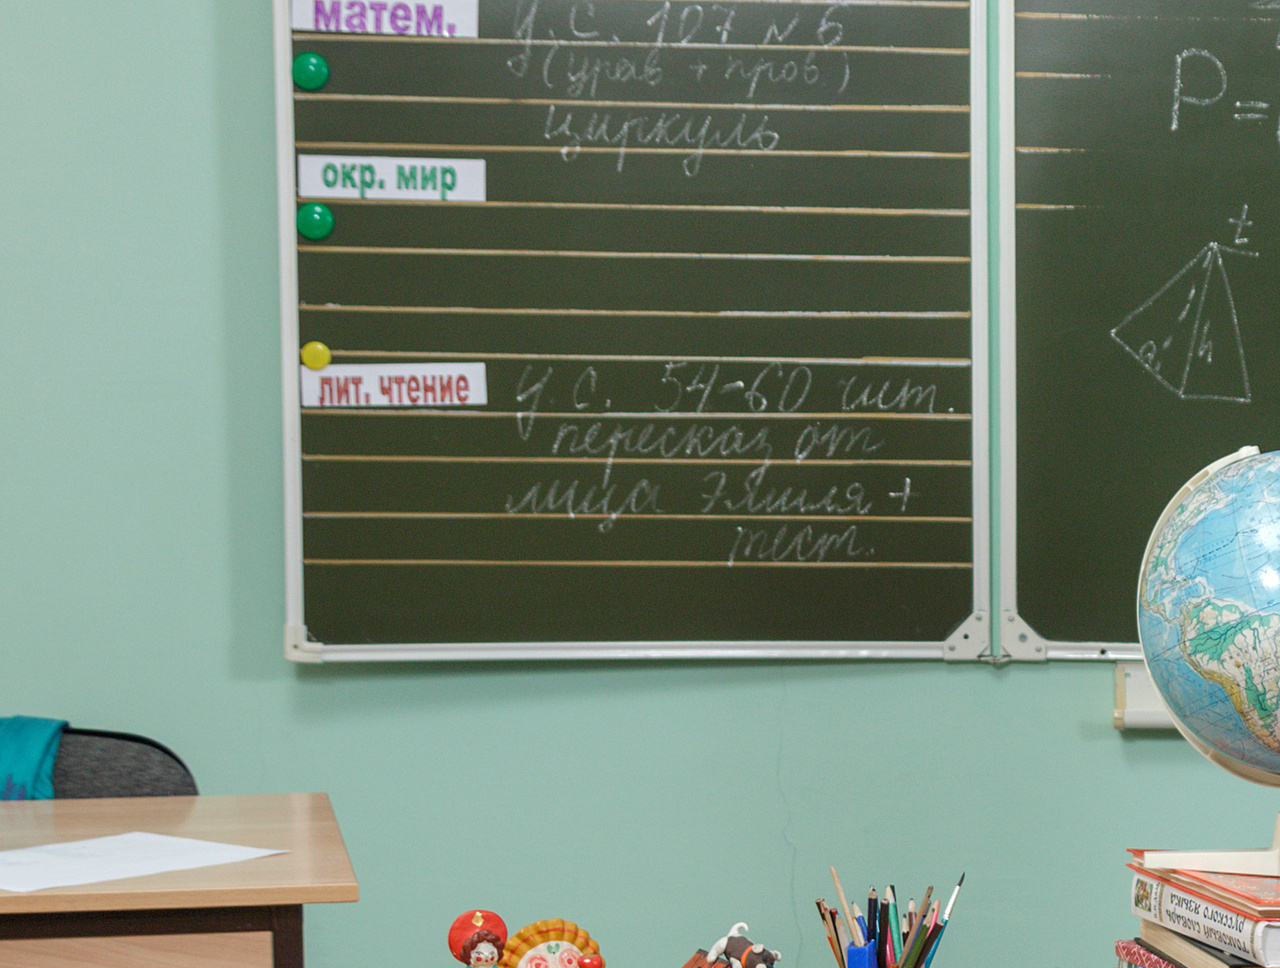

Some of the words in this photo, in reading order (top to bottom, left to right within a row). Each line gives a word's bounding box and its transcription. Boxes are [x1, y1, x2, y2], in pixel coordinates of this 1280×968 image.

[322, 162, 386, 200] окр.
[396, 164, 458, 200] мир
[319, 375, 372, 405] лит.
[379, 373, 471, 405] чтение
[794, 421, 884, 462] от
